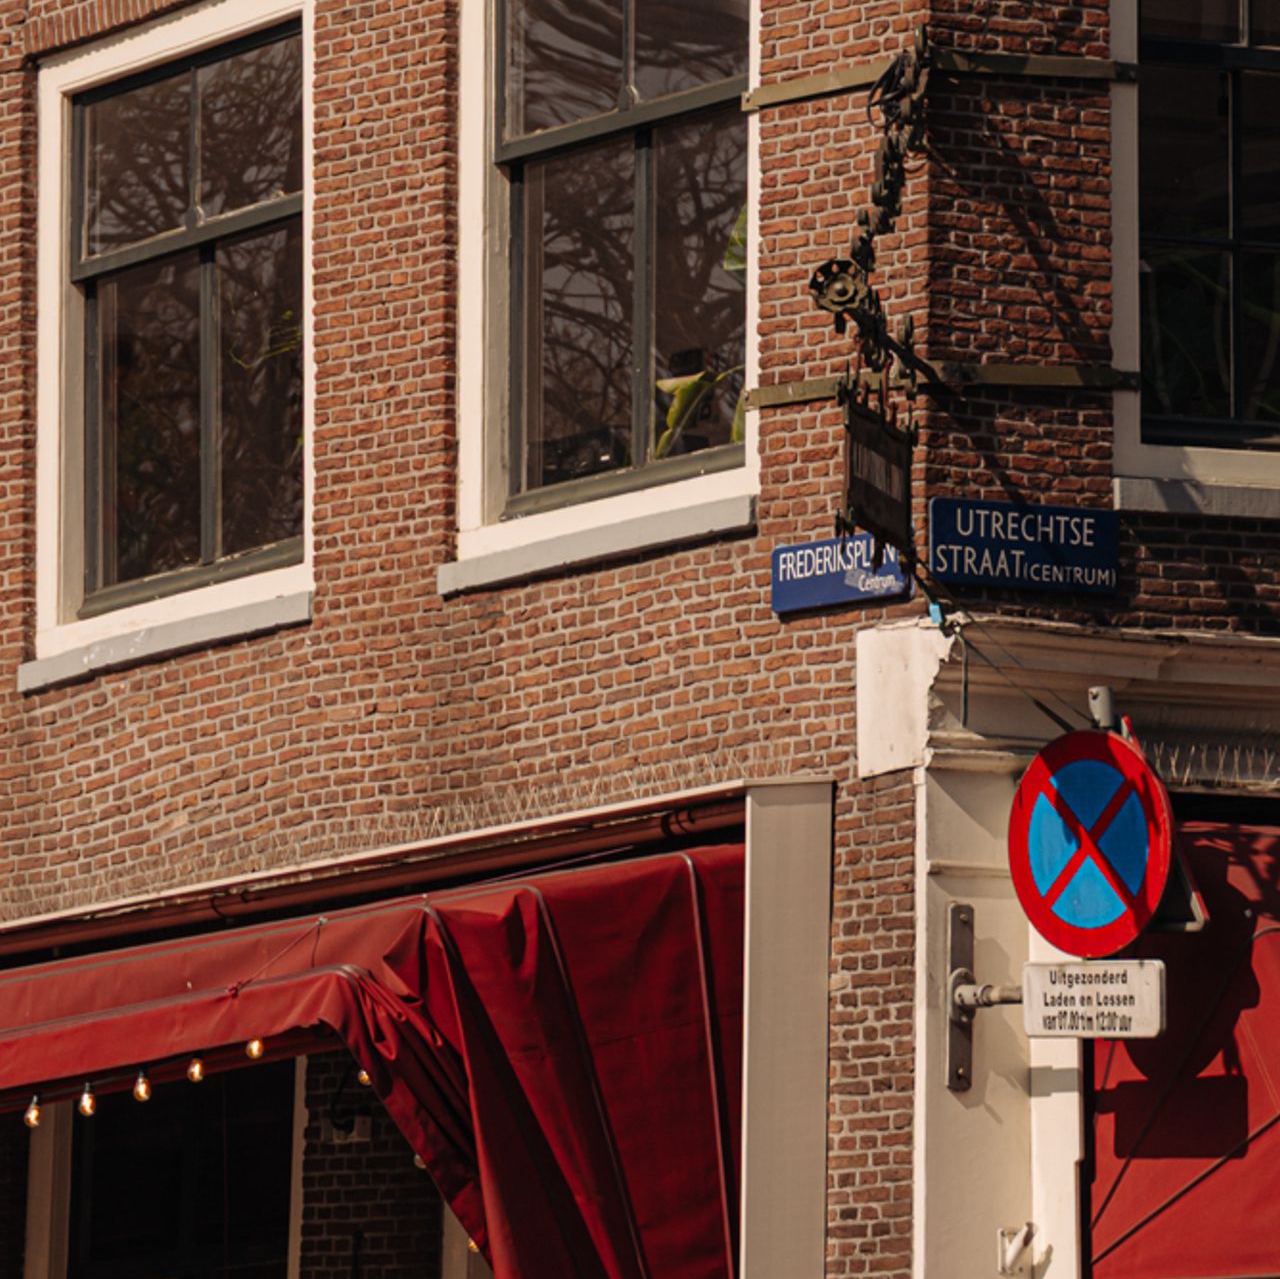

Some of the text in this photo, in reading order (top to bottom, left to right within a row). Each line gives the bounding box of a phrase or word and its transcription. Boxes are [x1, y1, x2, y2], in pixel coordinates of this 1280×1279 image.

[955, 507, 1096, 547] UTRECHTSE
[778, 537, 897, 582] FREDERIKSPLN
[935, 544, 1025, 578] STRAAT
[1049, 969, 1128, 989] Uitgezonderd
[1043, 992, 1135, 1007] Laden en Lossen
